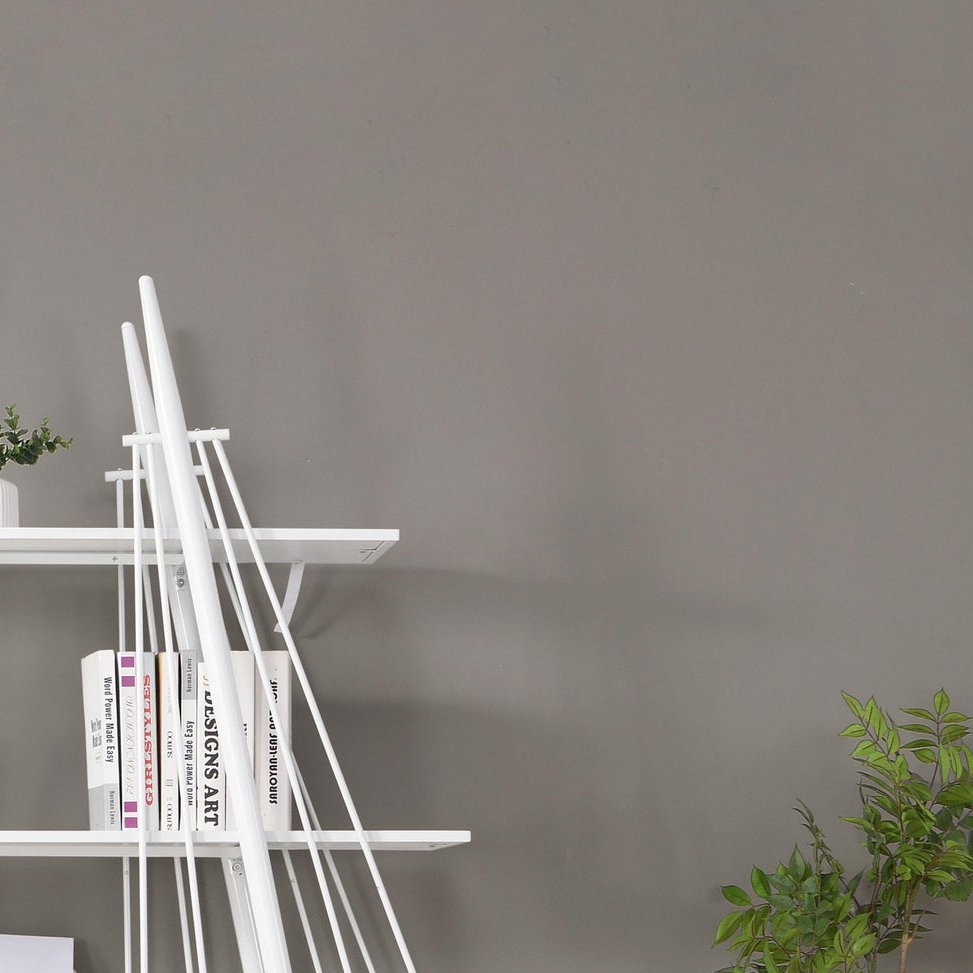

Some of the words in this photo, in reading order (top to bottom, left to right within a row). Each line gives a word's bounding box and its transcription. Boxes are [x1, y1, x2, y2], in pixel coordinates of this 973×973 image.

[104, 677, 113, 696] Word
[105, 698, 114, 721] Power
[106, 723, 115, 744] Made
[184, 720, 195, 738] Easy
[143, 674, 153, 806] GIRLSTYLES
[184, 740, 194, 760] Made
[105, 746, 115, 763] Easy
[269, 733, 278, 805] SAROYAN-LEAF
[204, 784, 219, 827] ART
